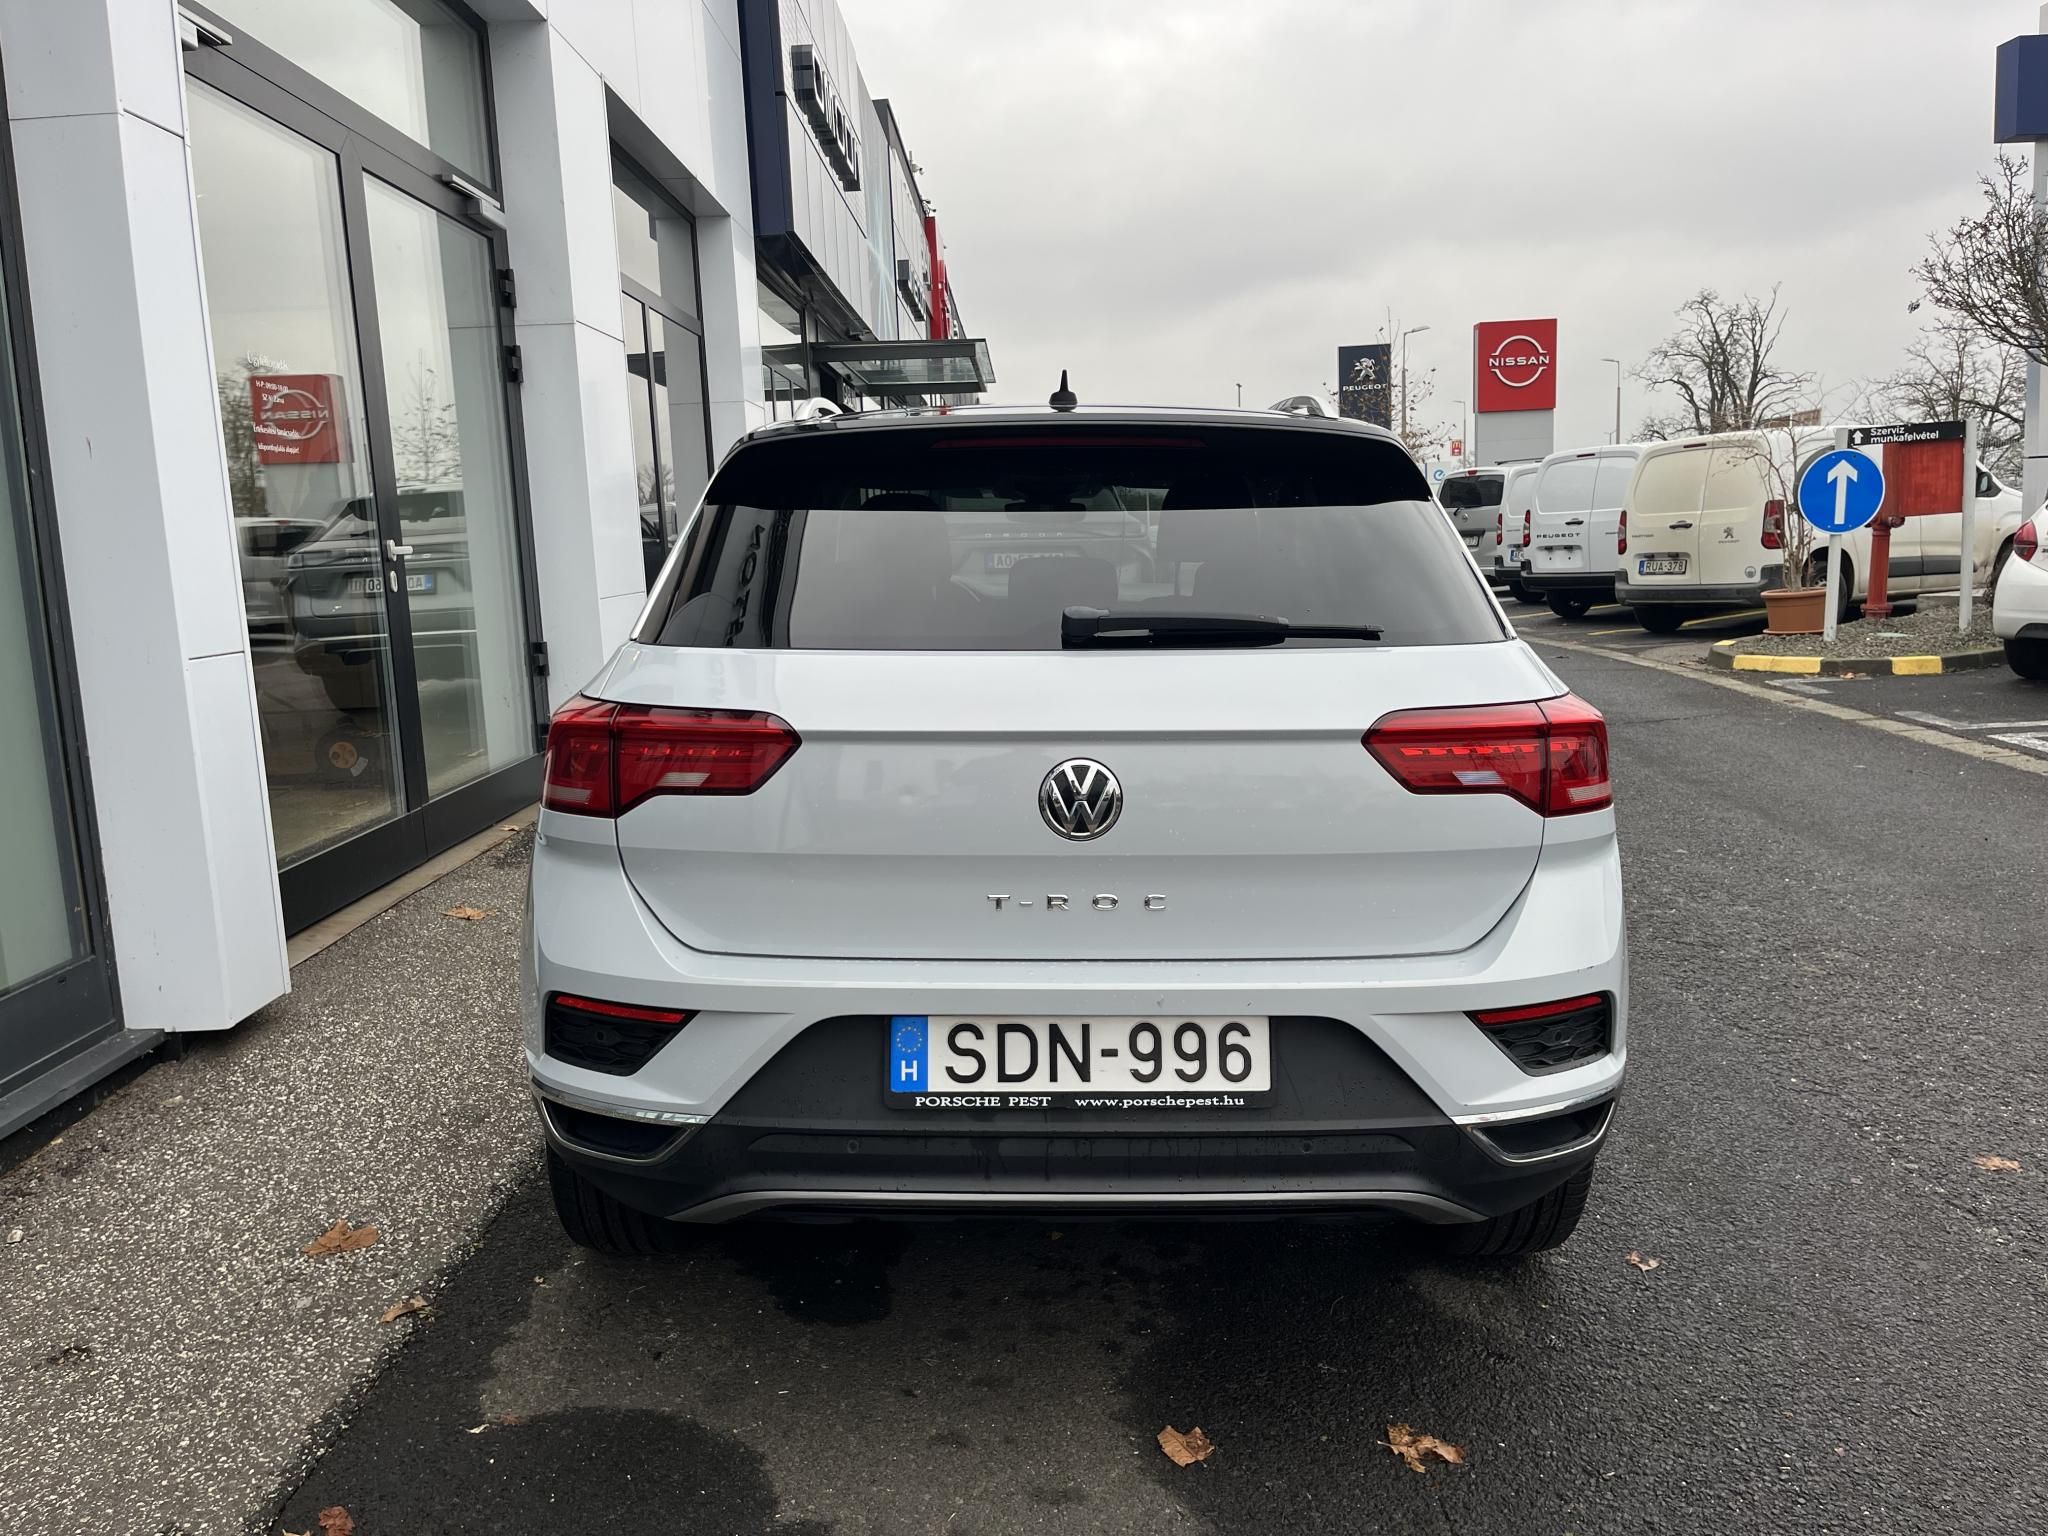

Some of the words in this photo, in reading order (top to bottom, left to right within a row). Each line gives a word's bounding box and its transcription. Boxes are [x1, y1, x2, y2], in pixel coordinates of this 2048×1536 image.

[1488, 355, 1550, 367] NISSAN
[1342, 383, 1388, 391] PEUGEOT
[1870, 426, 1905, 436] Szerviz
[1870, 430, 1939, 444] munkafelvétel
[1536, 532, 1581, 540] PEUGEOT
[1645, 561, 1683, 572] RUA-378
[987, 894, 1167, 911] T-ROC
[945, 1022, 1252, 1084] SDN-996
[900, 1060, 918, 1082] H
[915, 1096, 1001, 1107] PORSCHE
[1008, 1096, 1052, 1107] PEST
[1075, 1095, 1245, 1108] www.porschepest.hu
